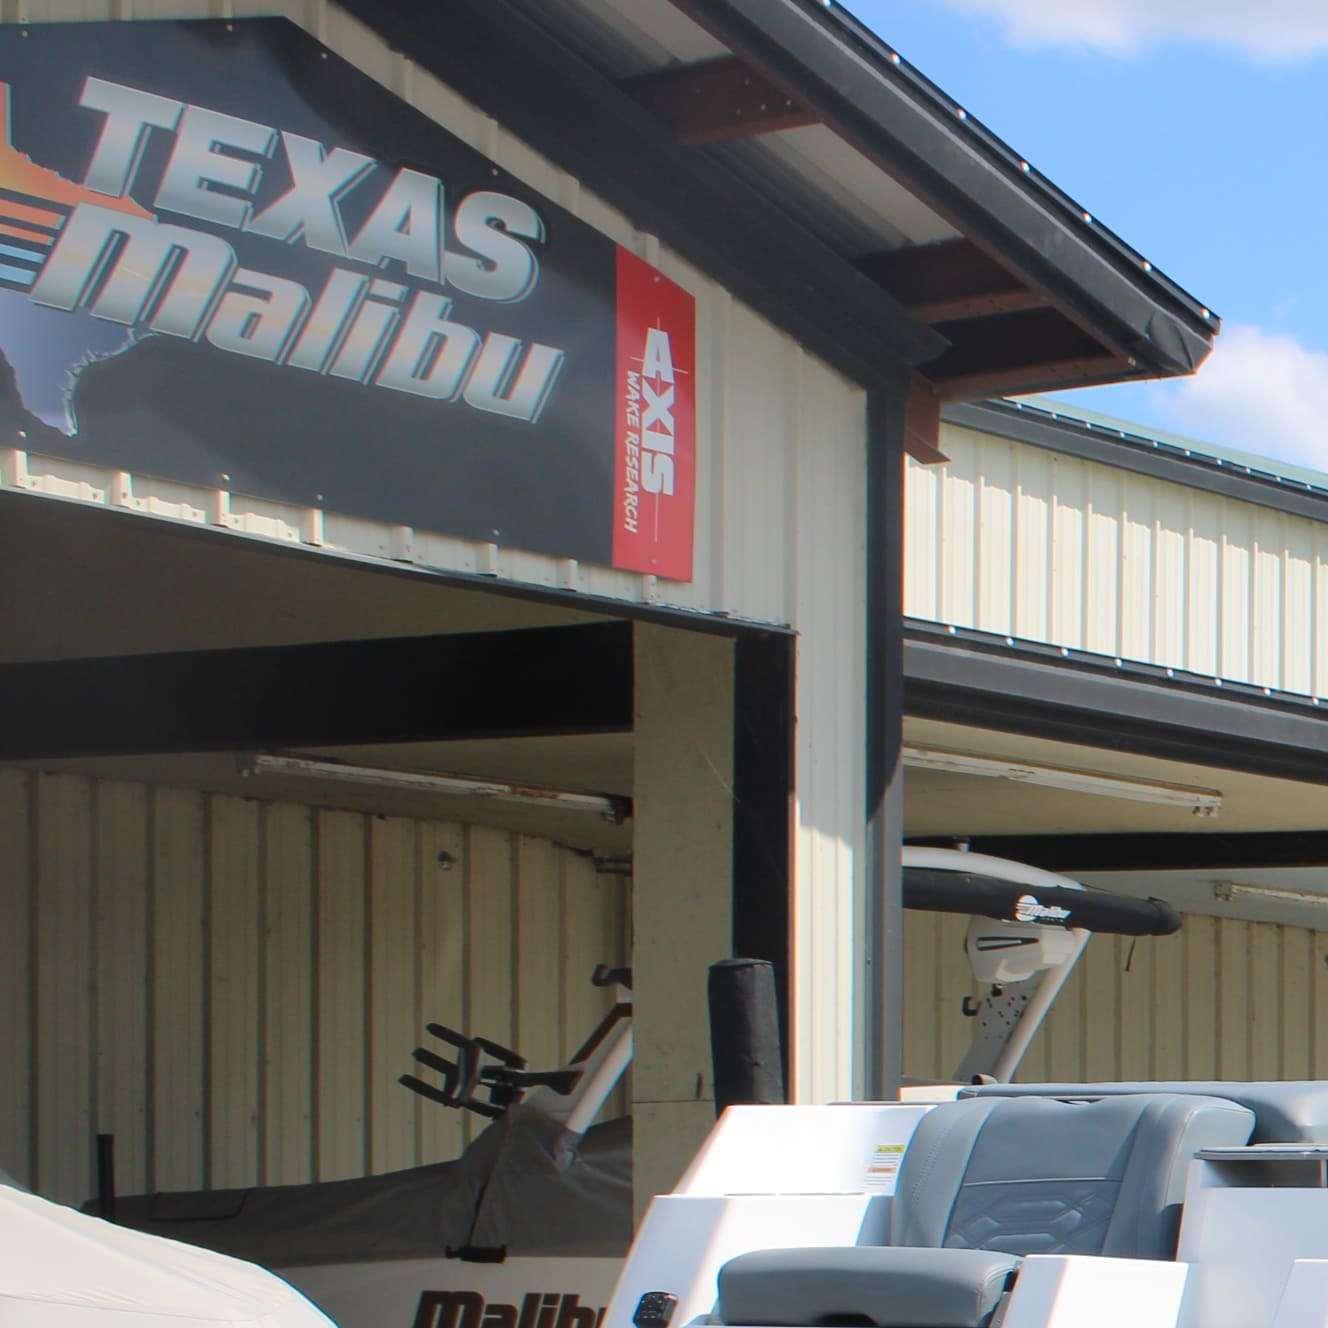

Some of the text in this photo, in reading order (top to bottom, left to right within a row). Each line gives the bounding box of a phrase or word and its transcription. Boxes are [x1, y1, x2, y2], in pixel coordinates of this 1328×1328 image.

[80, 76, 546, 304] TEXAS
[28, 201, 565, 424] Malibu
[623, 370, 640, 533] WAKE RESEARCH
[641, 327, 676, 497] AXIS
